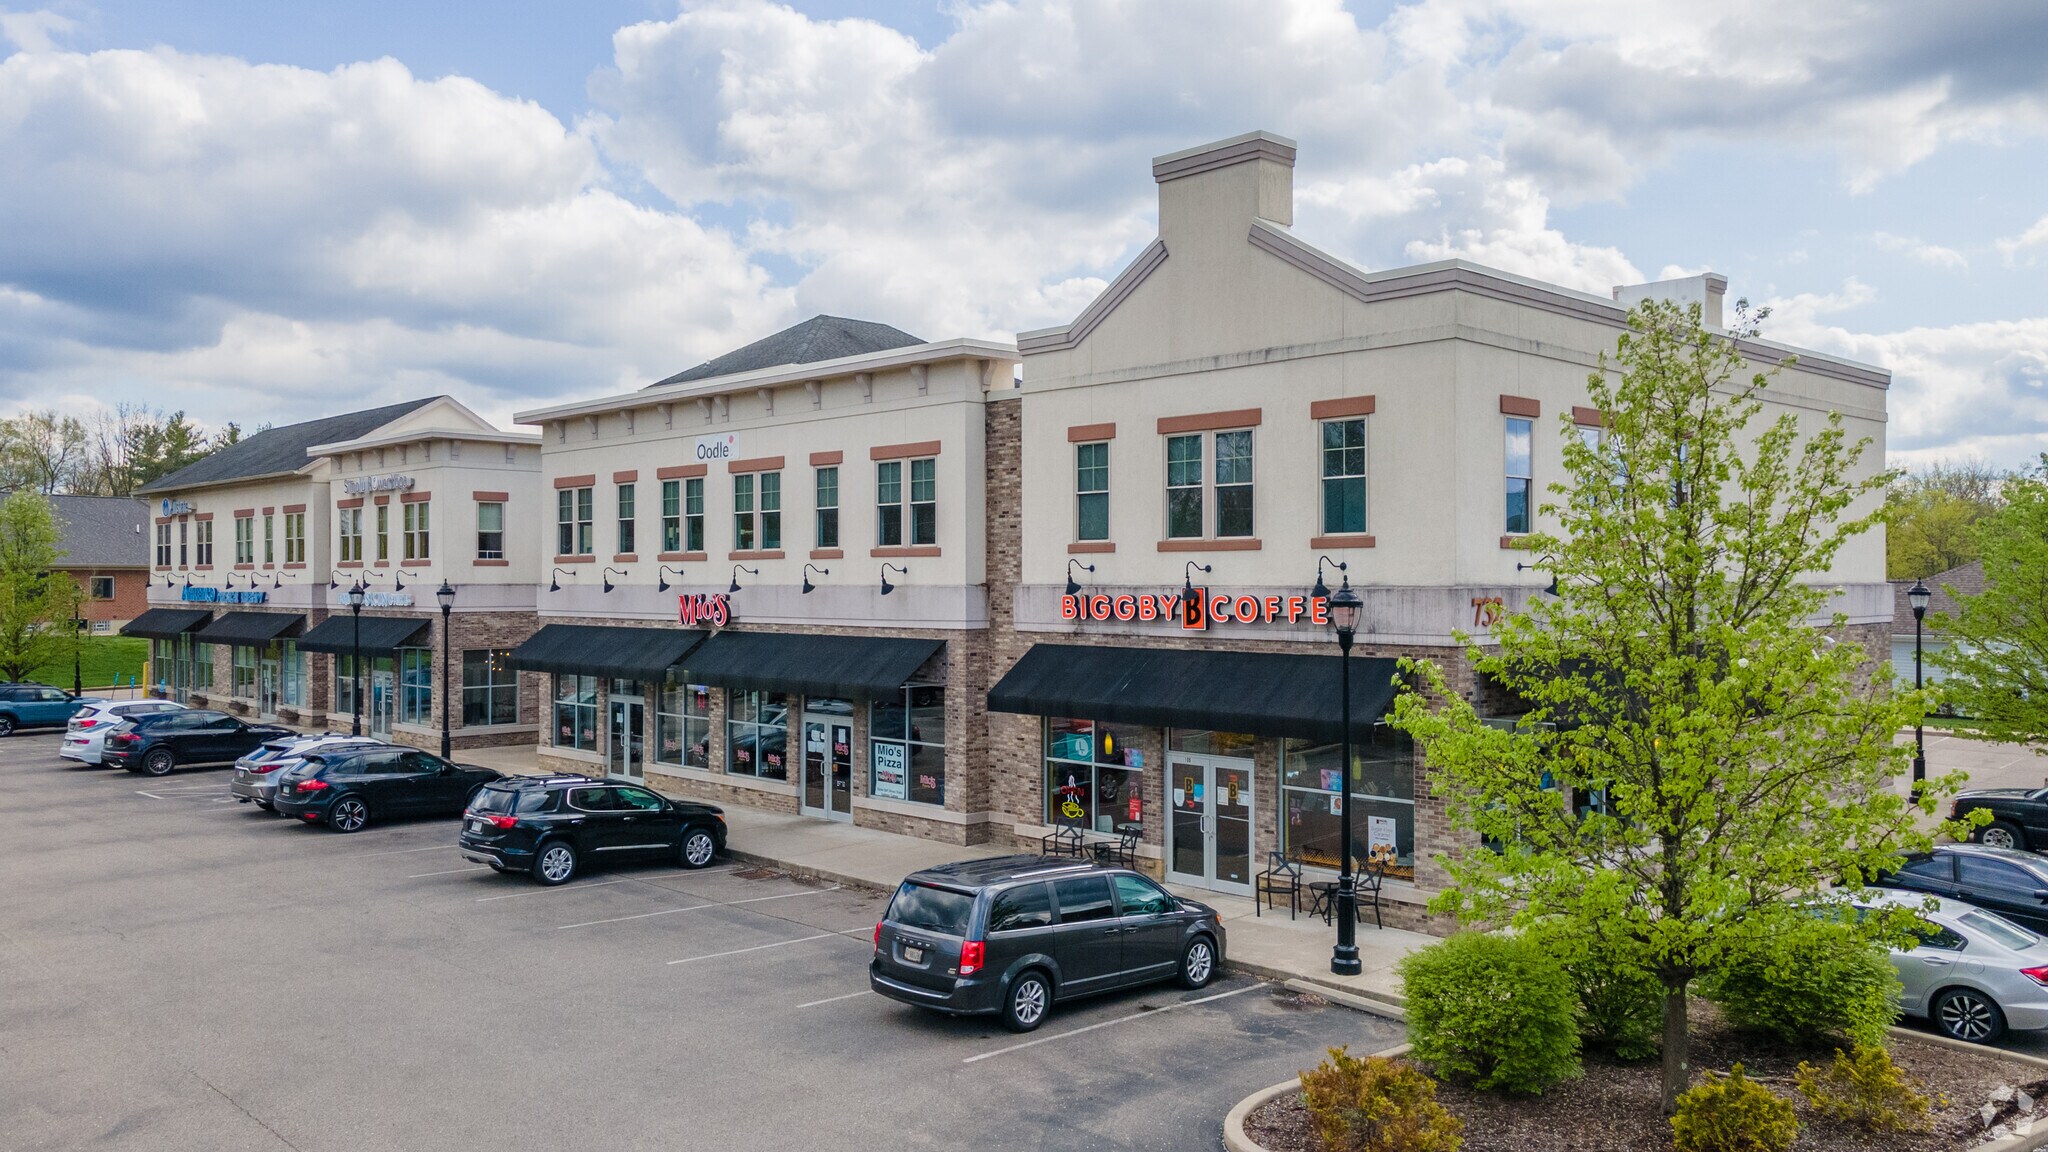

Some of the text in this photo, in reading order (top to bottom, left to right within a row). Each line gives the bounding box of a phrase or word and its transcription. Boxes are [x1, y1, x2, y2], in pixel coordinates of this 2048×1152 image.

[697, 441, 729, 459] Oodle
[1061, 595, 1178, 621] BIGGBY
[1210, 595, 1331, 624] COFFE
[878, 744, 902, 757] Mio's
[878, 756, 902, 769] Pizza
[1185, 778, 1193, 792] B
[1229, 783, 1237, 798] B
